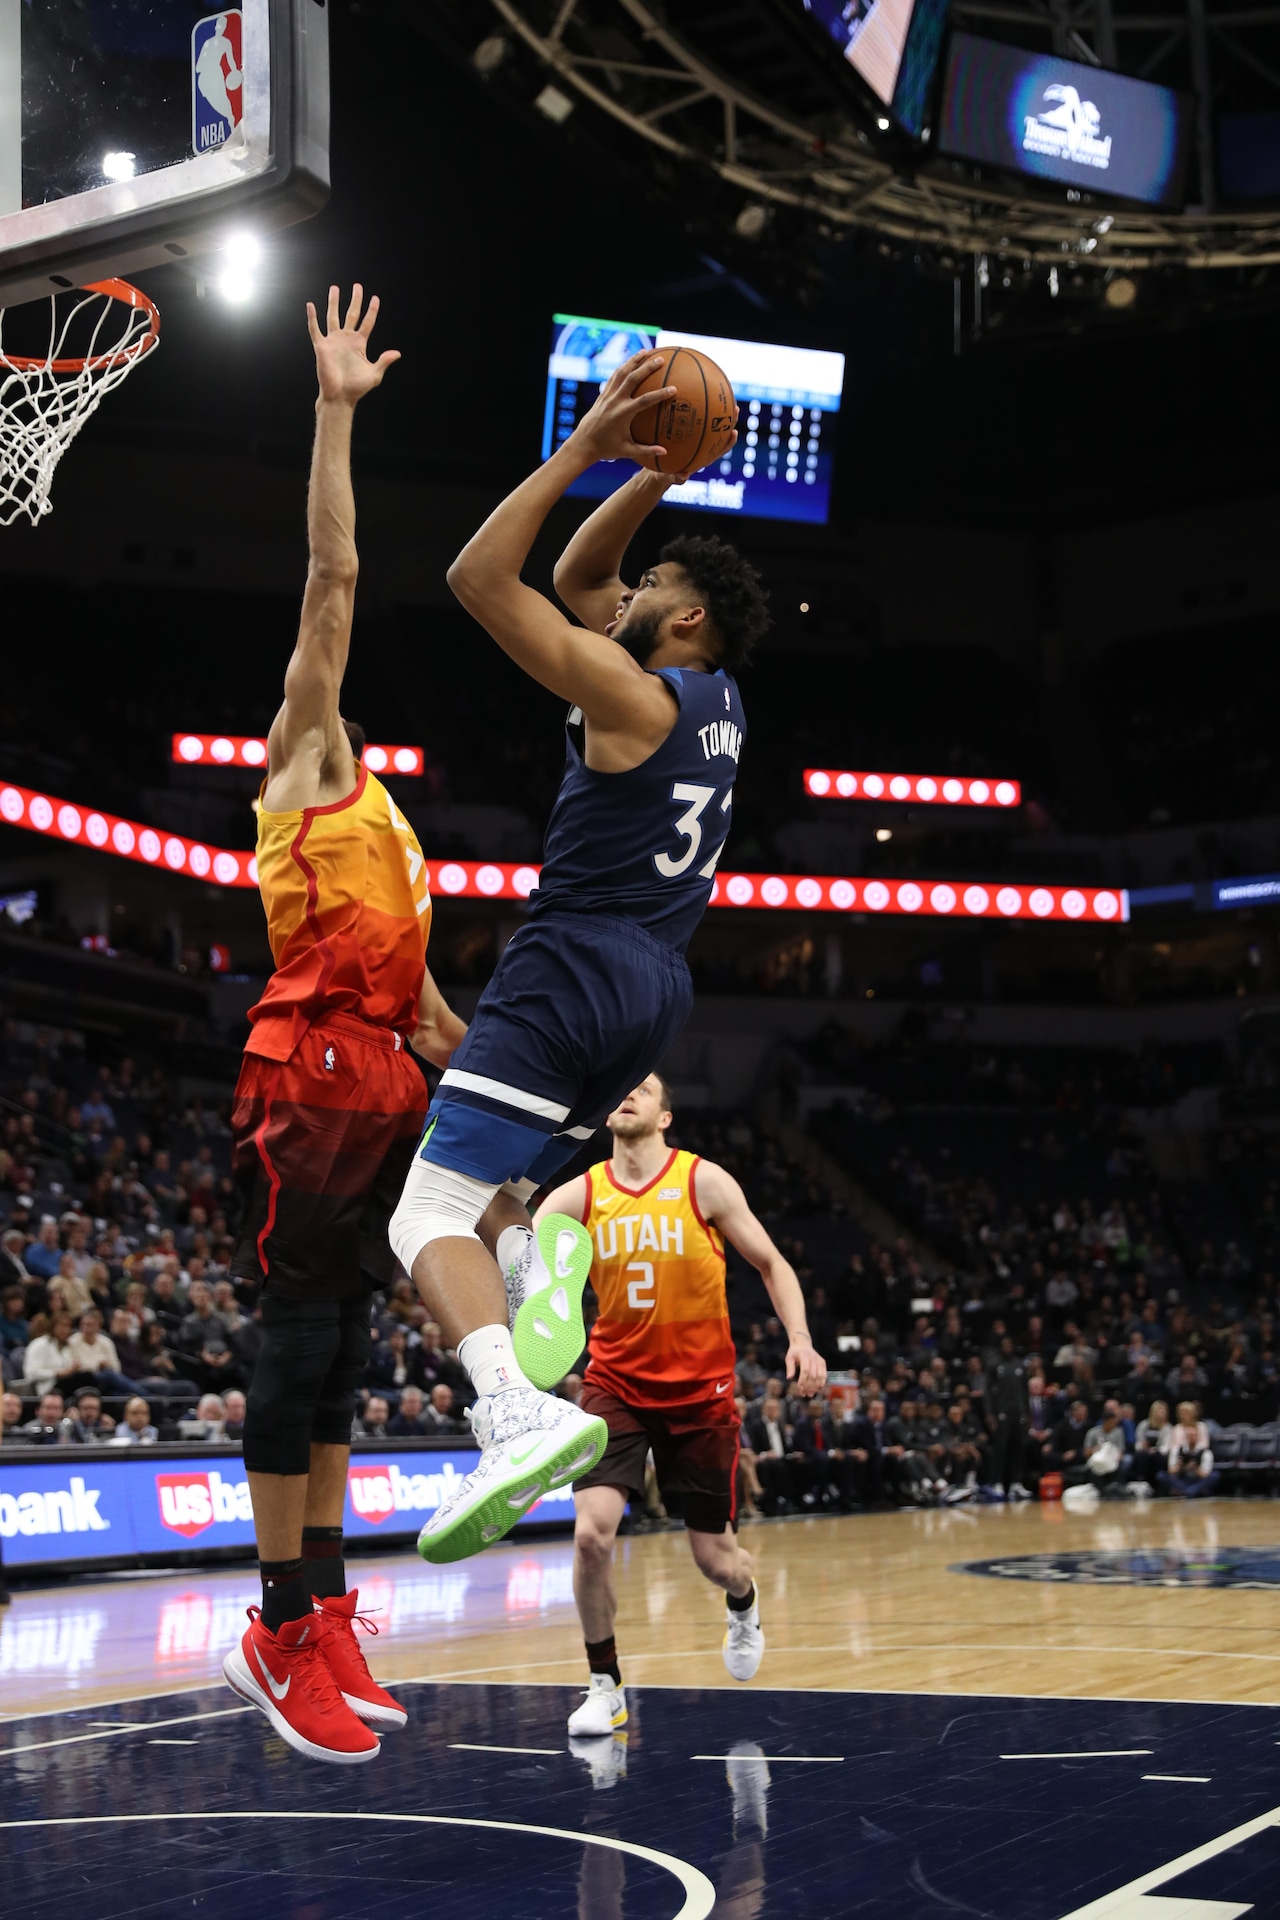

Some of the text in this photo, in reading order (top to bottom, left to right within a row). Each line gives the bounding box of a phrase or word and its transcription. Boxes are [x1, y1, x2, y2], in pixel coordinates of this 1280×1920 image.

[201, 120, 226, 147] NBA
[698, 720, 742, 764] TOWNS
[596, 1214, 684, 1260] UTAH
[626, 1261, 656, 1309] 2
